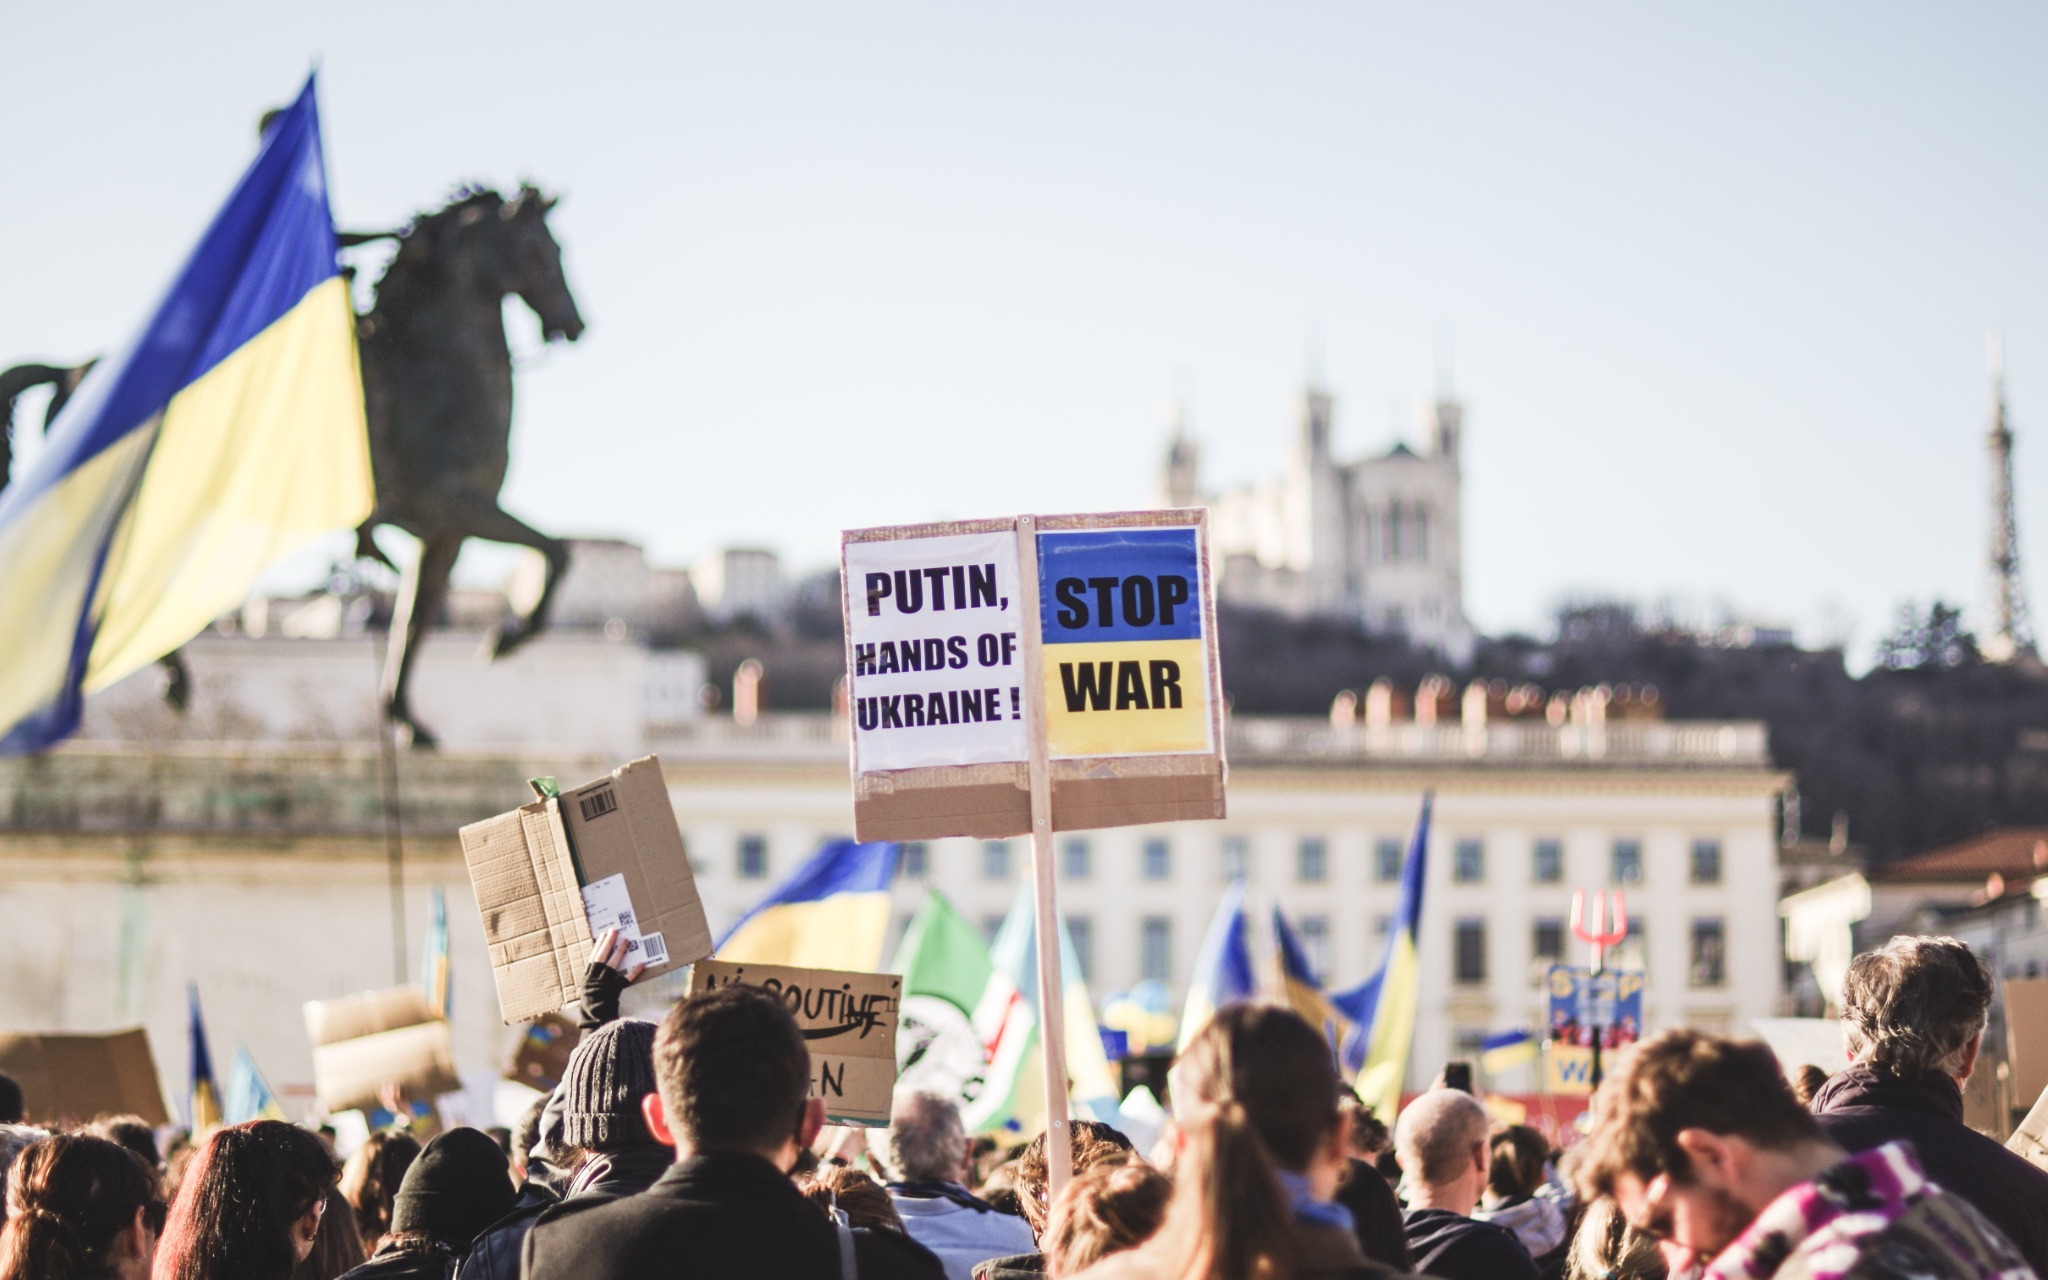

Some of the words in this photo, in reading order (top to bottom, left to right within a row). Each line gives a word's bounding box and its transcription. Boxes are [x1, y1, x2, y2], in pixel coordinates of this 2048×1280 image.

[865, 563, 1009, 617] PUTIN,
[1055, 575, 1188, 629] STOP
[855, 635, 968, 677] HANDS
[977, 632, 1017, 667] OF
[857, 688, 1002, 731] UKRAINE
[1060, 660, 1182, 712] WAR
